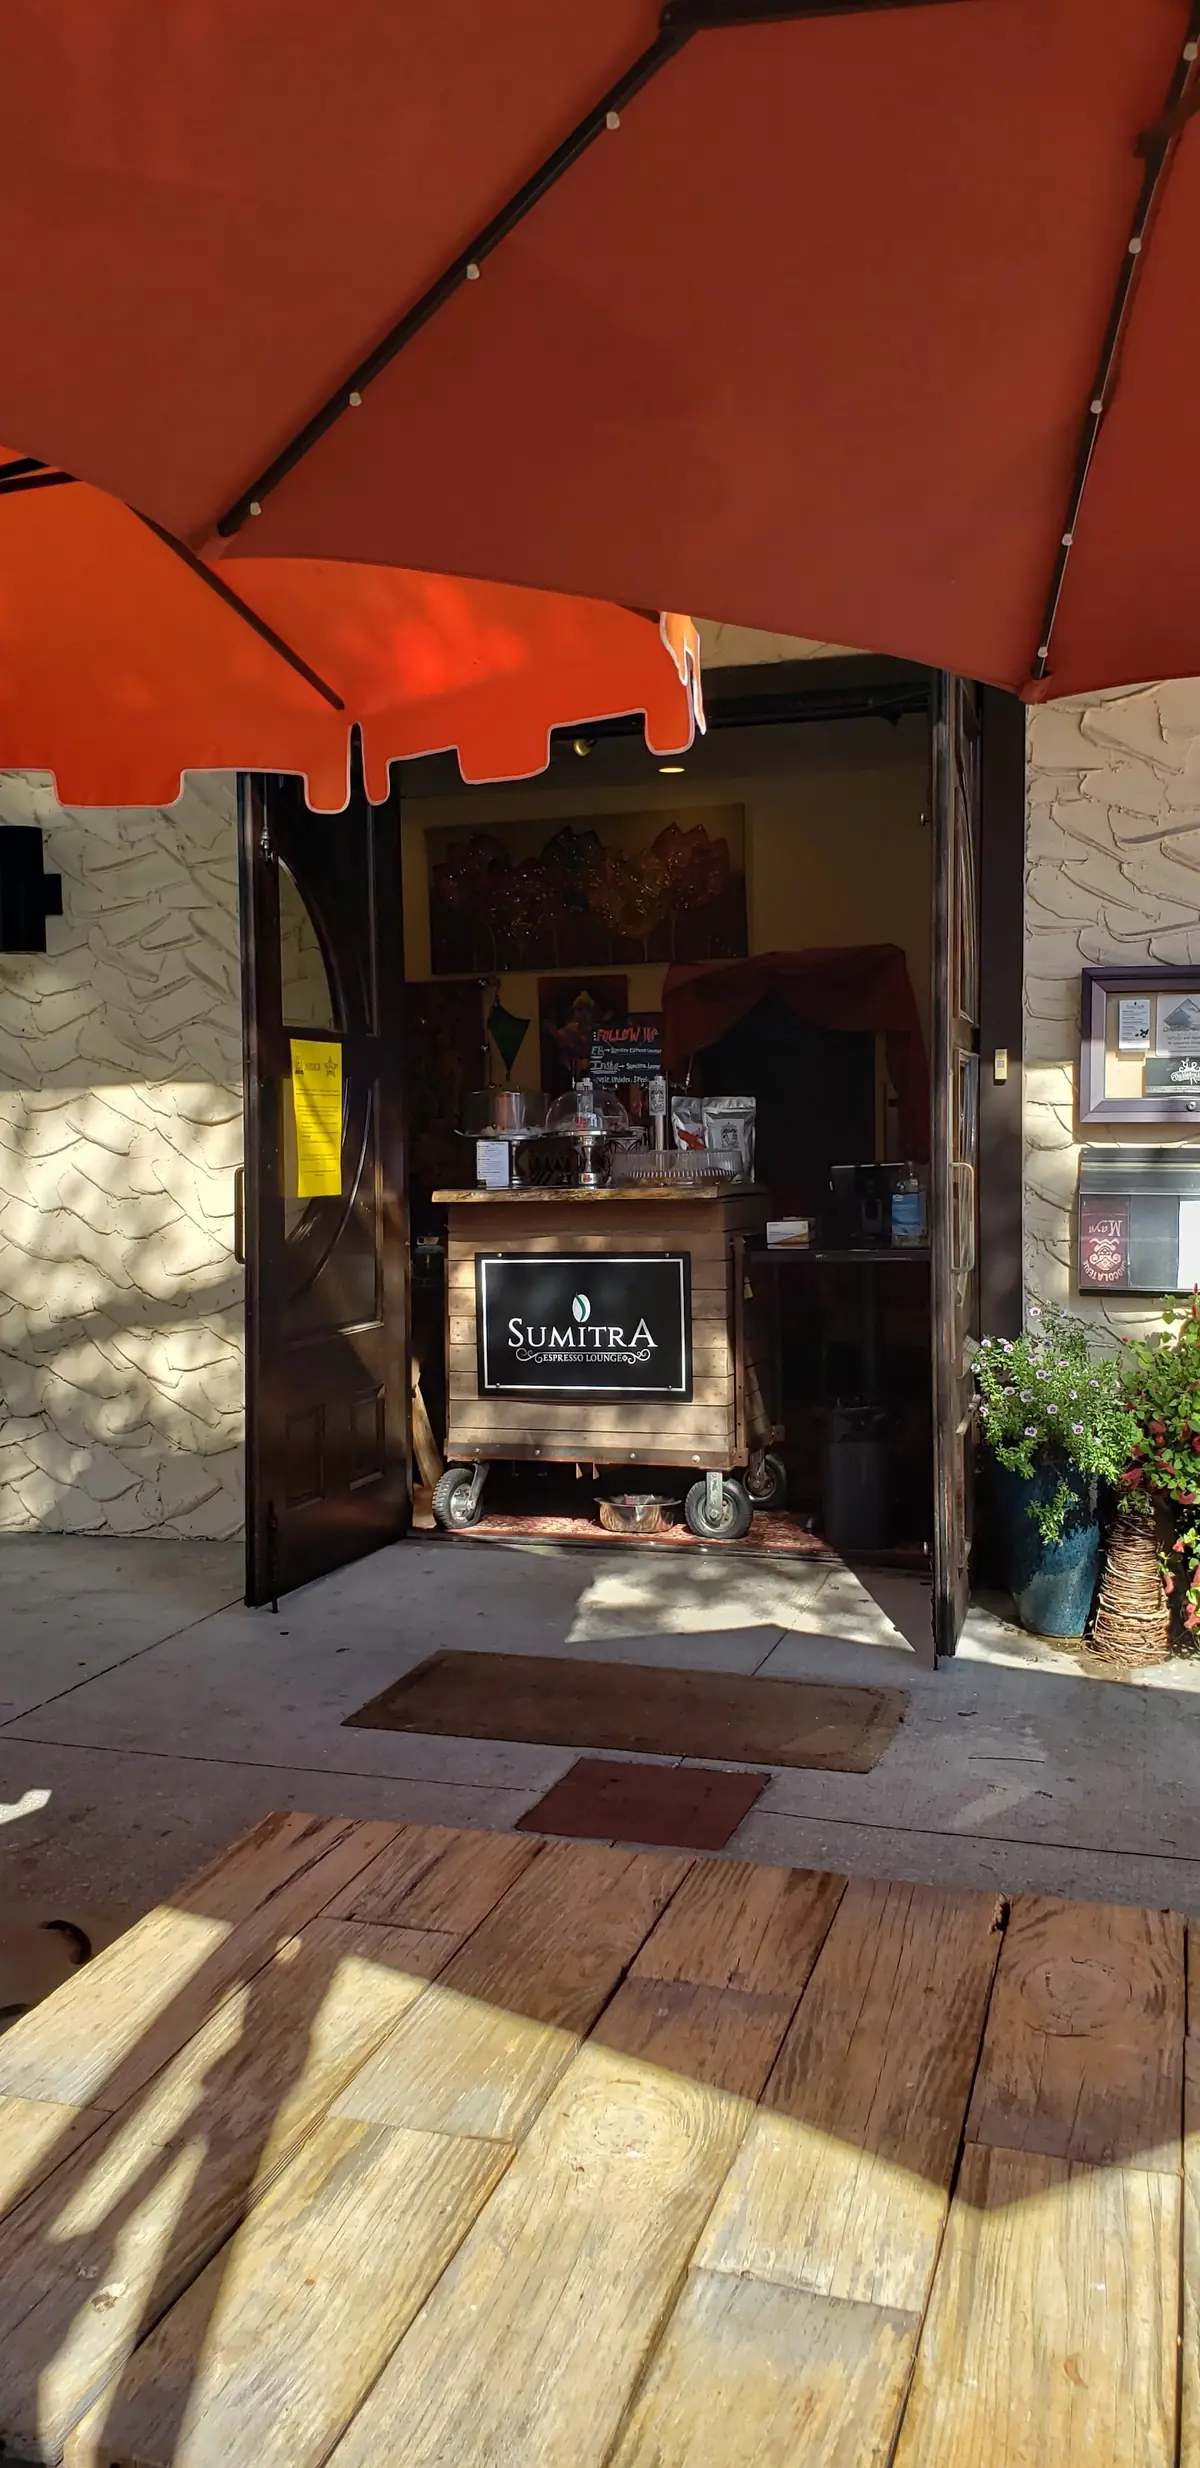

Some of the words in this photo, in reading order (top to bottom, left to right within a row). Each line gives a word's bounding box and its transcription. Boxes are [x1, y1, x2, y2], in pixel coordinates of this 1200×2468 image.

[596, 1027, 640, 1042] FOLLOW
[1088, 1220, 1123, 1237] Maya
[508, 1317, 659, 1348] SUMITRA
[543, 1354, 584, 1362] ESPRESSO
[586, 1354, 622, 1362] LOUNGE
